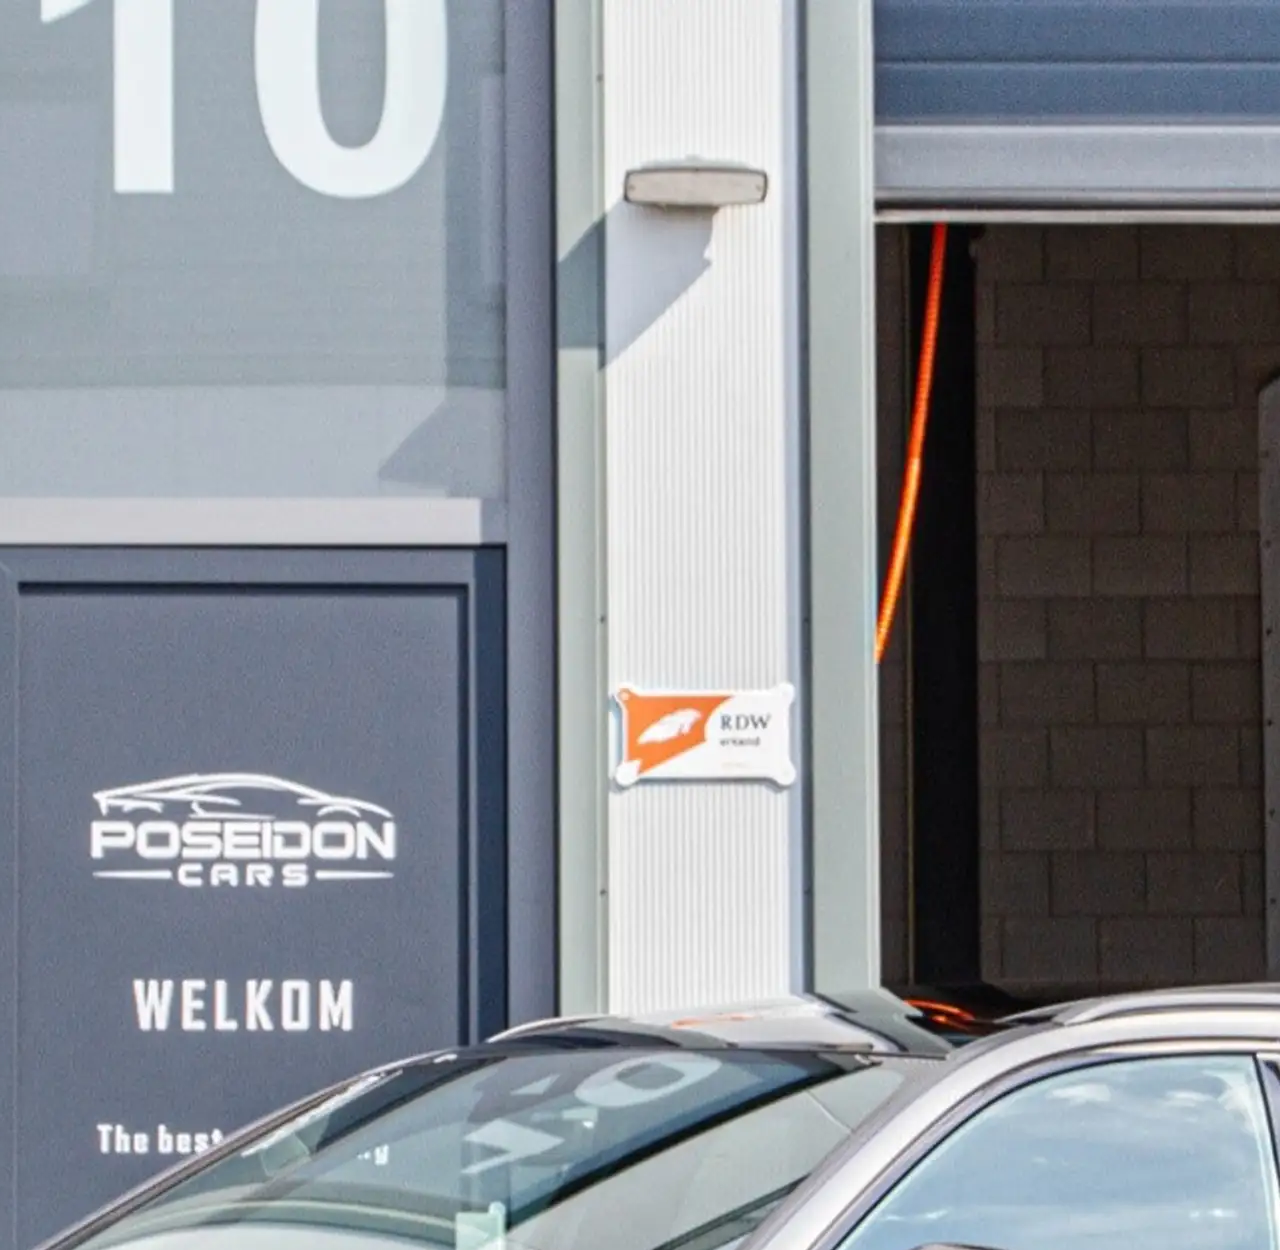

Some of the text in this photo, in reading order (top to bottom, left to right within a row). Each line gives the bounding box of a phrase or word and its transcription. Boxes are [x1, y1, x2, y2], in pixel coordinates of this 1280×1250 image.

[41, 0, 447, 197] 10
[720, 713, 771, 731] RDW
[90, 821, 396, 860] POSEIDON
[177, 862, 309, 887] CARS
[133, 979, 353, 1032] WELKOM
[96, 1123, 149, 1154] The
